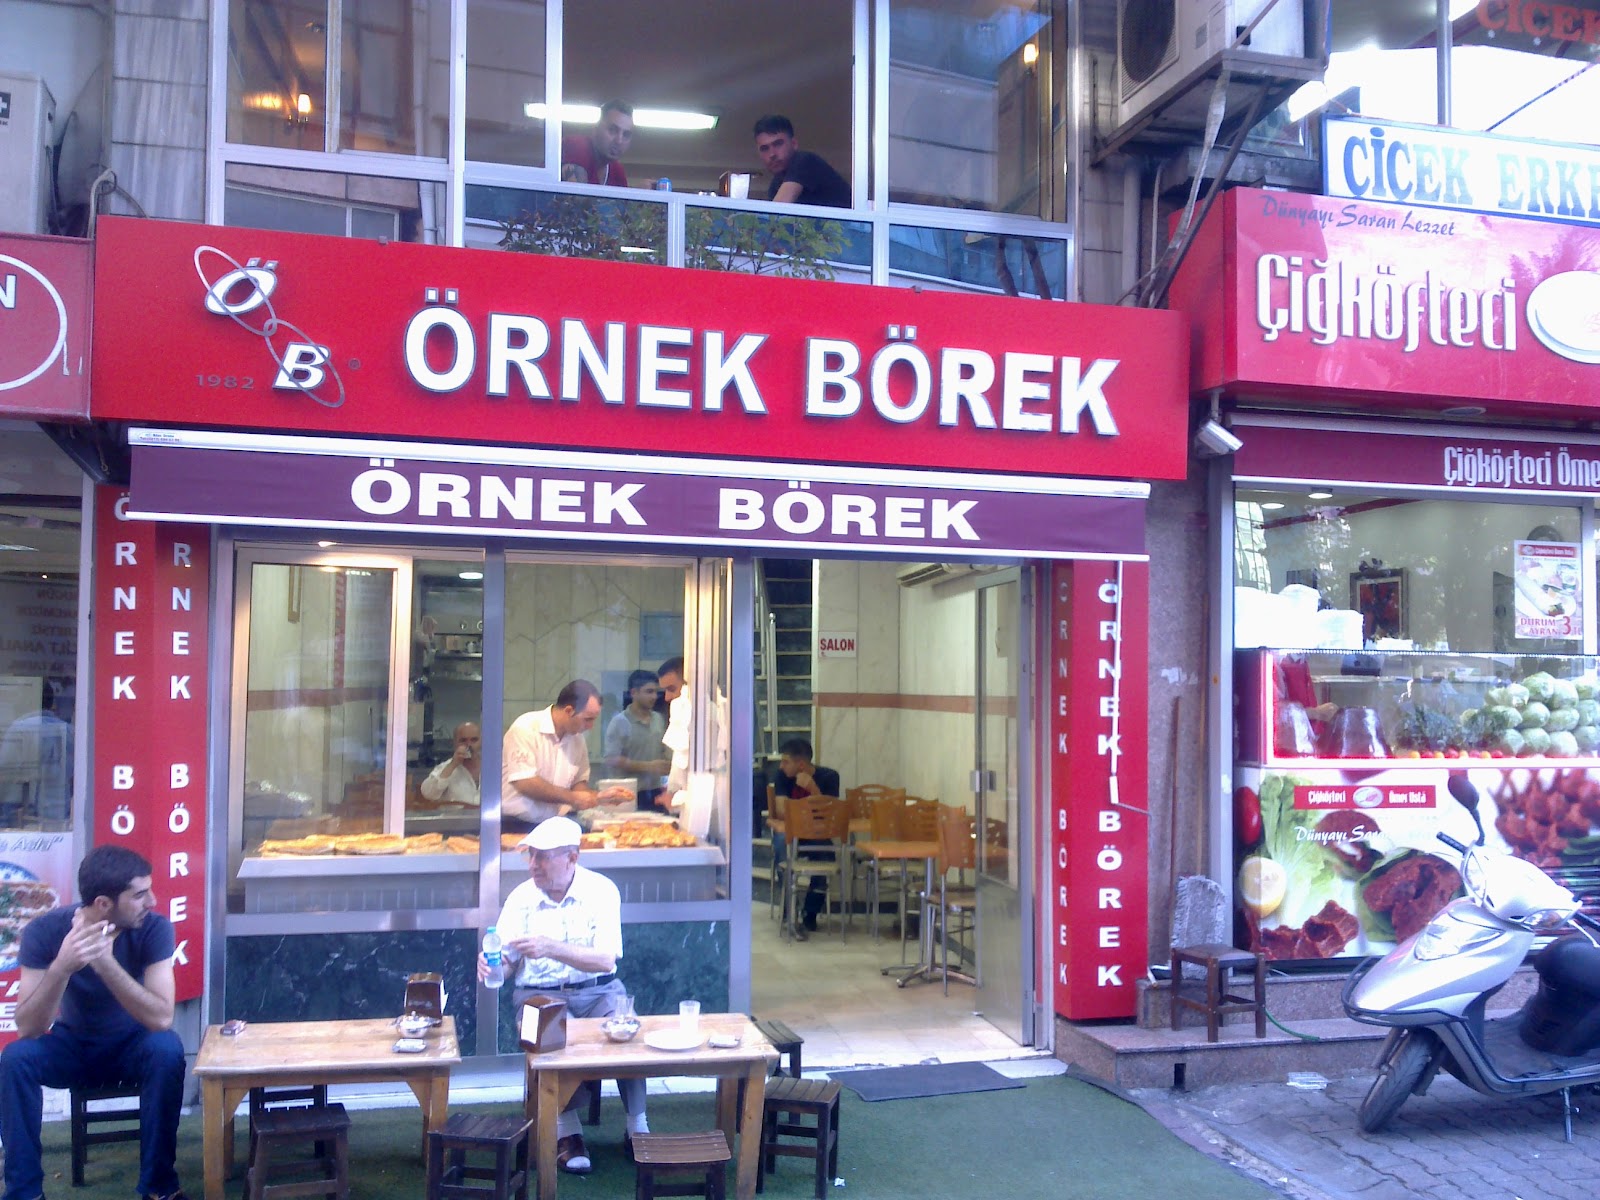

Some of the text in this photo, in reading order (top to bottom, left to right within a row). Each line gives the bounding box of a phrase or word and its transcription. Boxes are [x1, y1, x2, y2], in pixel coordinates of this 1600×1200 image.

[1259, 194, 1455, 236] Dünyayı Saran Lezzet
[1255, 253, 1517, 353] Çiğköfteci
[195, 373, 255, 391] 1982
[404, 286, 1122, 438] ÖRNEK BÖREK
[350, 457, 982, 542] ÖRNEK BÖREK
[1443, 446, 1553, 488] Çiğköfteci
[171, 541, 191, 701] RNEK
[820, 638, 855, 651] SALON
[1293, 825, 1347, 845] Dünyayı
[1058, 808, 1068, 985] BÖREK
[1096, 810, 1123, 987] BÖREK
